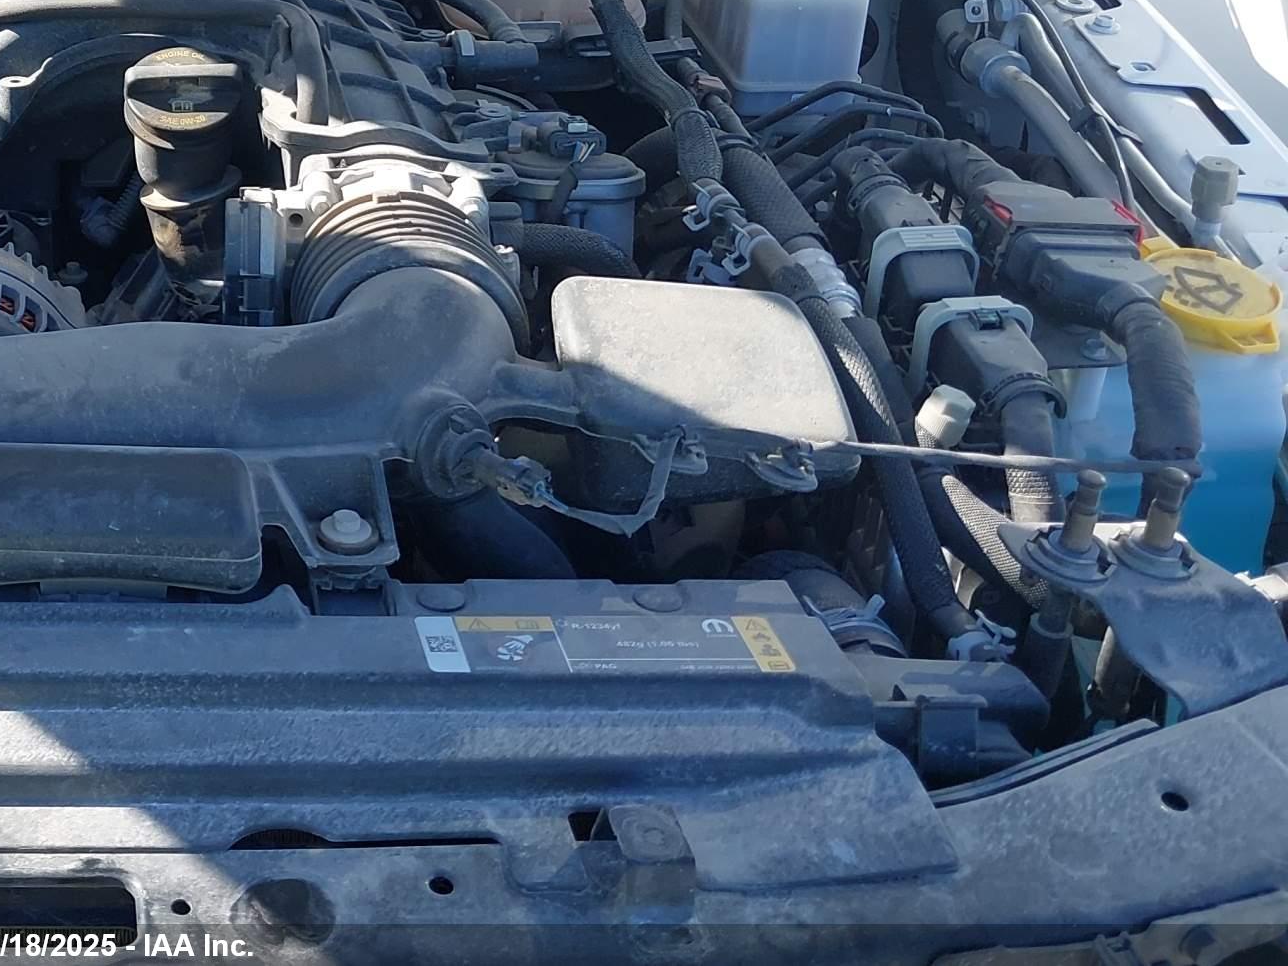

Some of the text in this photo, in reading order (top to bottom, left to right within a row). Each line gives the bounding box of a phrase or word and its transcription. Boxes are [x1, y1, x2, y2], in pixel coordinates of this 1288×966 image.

[155, 50, 206, 61] ENGINE OIL
[159, 115, 179, 125] SAE
